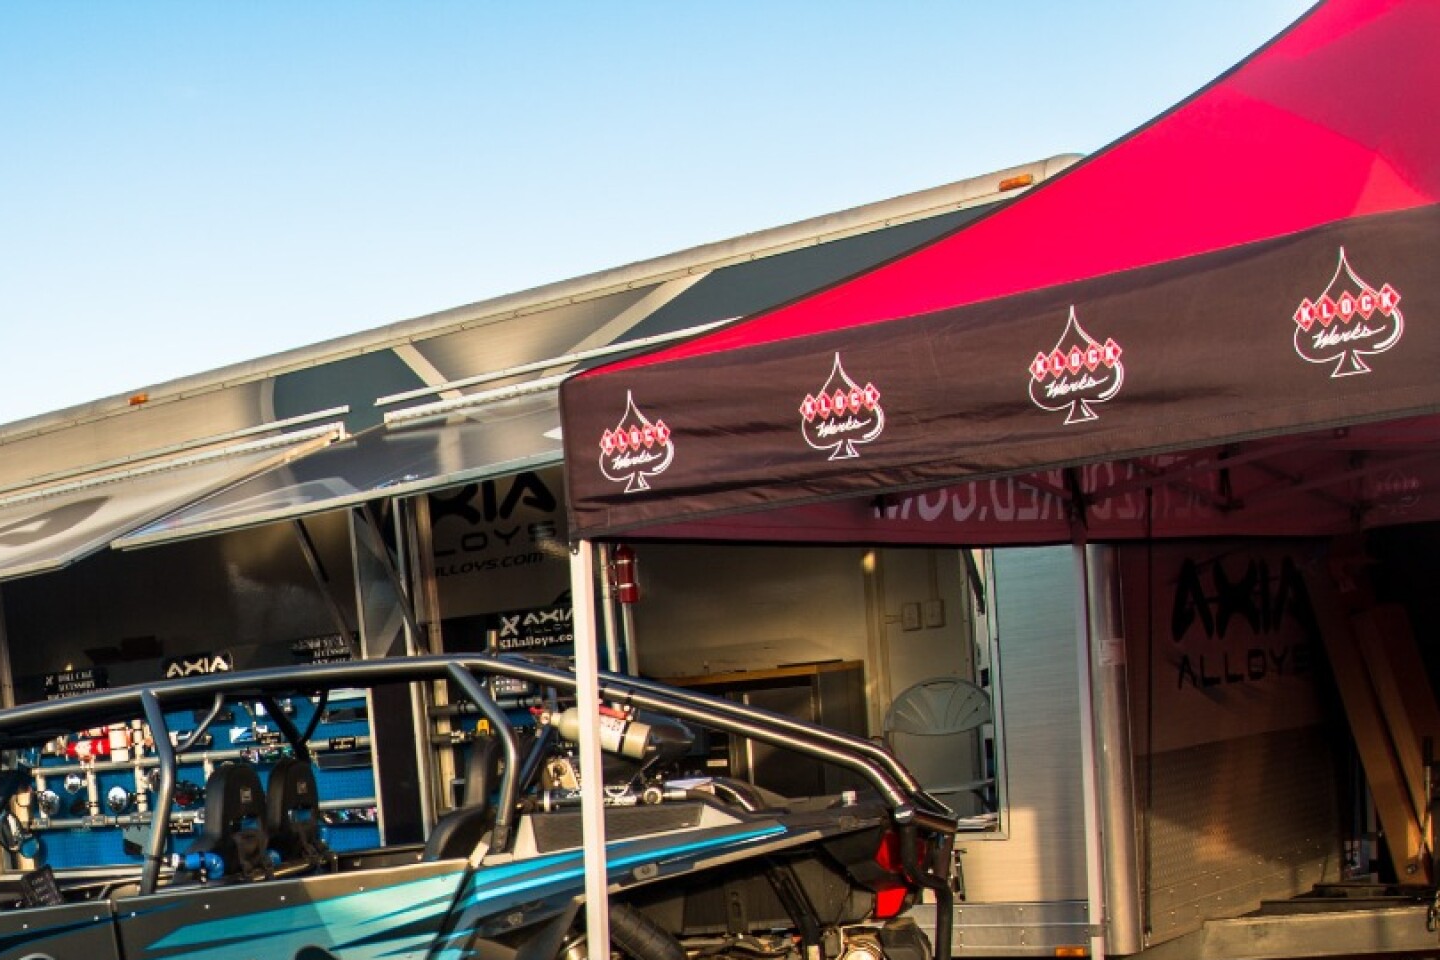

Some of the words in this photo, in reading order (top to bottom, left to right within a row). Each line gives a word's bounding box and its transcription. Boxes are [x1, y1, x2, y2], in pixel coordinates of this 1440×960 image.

[1296, 288, 1397, 325] KLOCK
[1032, 342, 1119, 378] KLOCK
[801, 386, 878, 418] KLOCK
[602, 422, 668, 453] KLOCK
[1172, 557, 1316, 641] AXIA
[166, 655, 229, 678] AXIA
